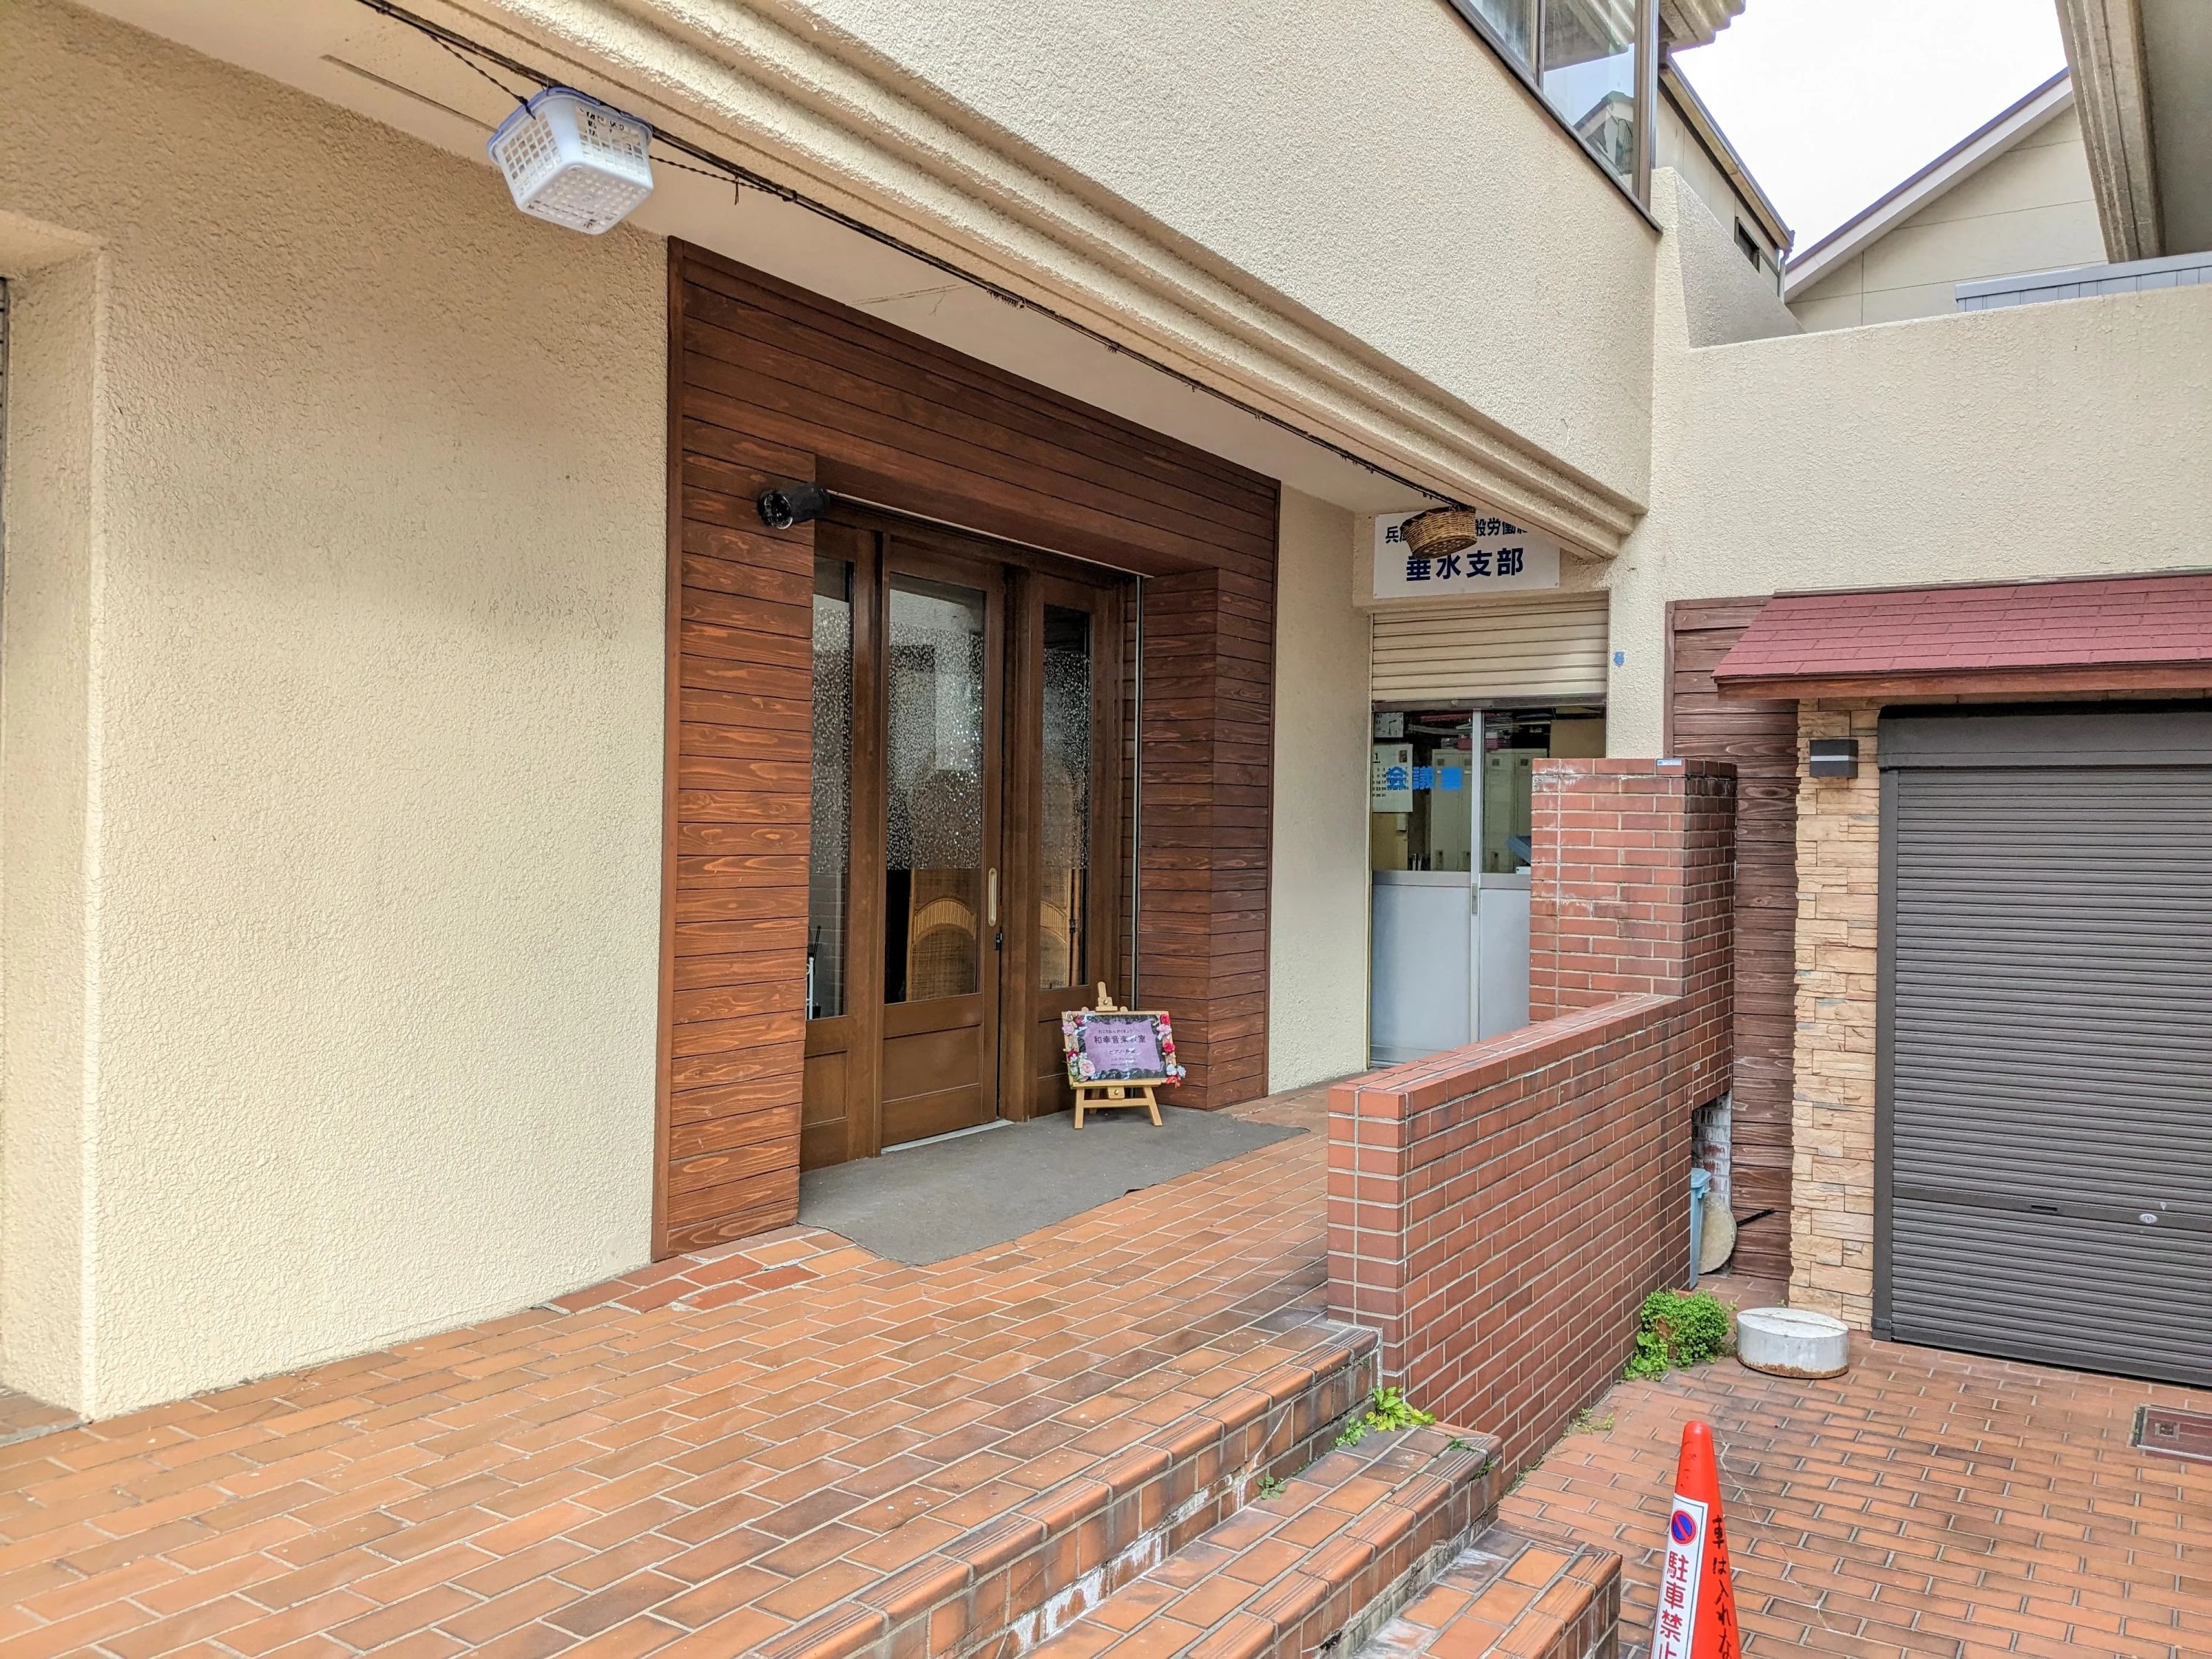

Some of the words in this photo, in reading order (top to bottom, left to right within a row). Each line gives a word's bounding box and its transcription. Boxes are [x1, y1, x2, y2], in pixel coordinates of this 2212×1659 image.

[1406, 547, 1524, 582] 垂水支部
[1659, 1550, 1689, 1659] 駐車禁止
